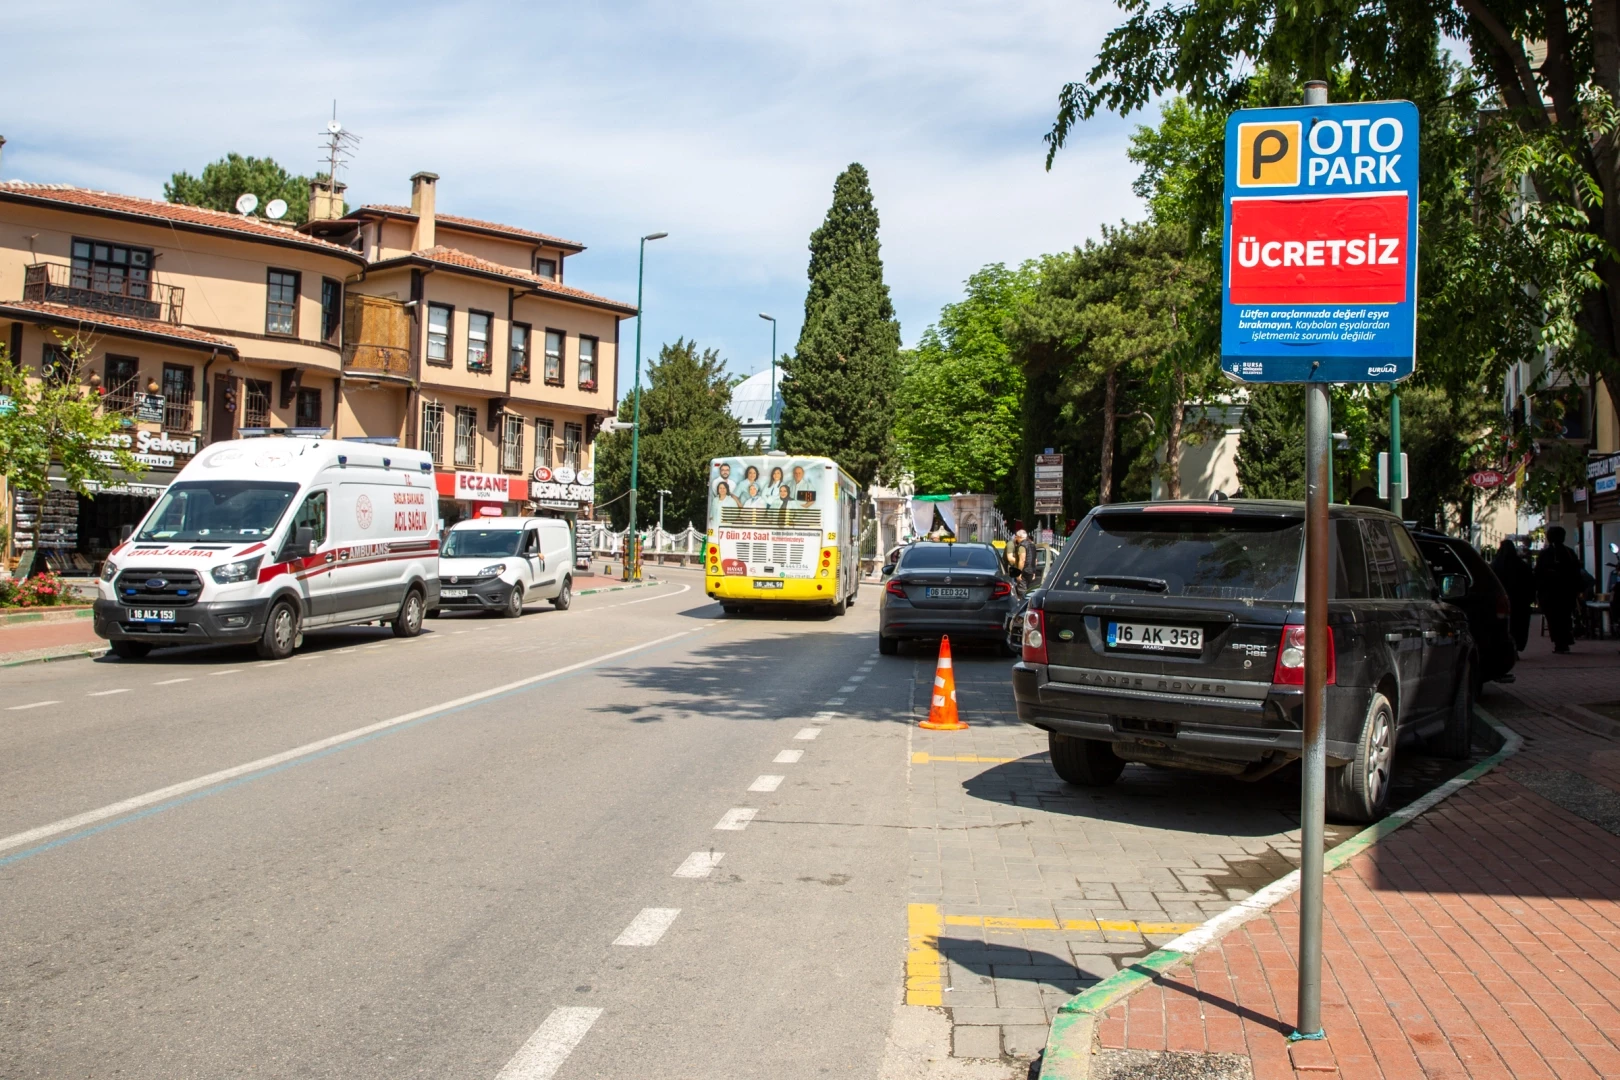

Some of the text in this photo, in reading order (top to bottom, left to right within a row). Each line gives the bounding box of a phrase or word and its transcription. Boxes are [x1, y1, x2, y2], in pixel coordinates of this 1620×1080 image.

[1309, 117, 1404, 155] OTO
[1252, 129, 1289, 180] P
[1308, 154, 1402, 185] PARK
[1237, 233, 1399, 267] ÜCRETSİZ
[1240, 309, 1389, 320] Lütfen araçlarınızda değerli eşya
[1238, 320, 1390, 331] bırakmayın. Kaybolan eşyalardan
[1251, 331, 1376, 342] işletmemiz sorumlu değildir
[136, 430, 197, 454] Şekeri
[460, 475, 508, 492] ECZANE
[394, 511, 407, 531] ACİL
[407, 509, 427, 531] SAĞLIK
[719, 531, 770, 541] 7 Gün 24 Saat
[350, 542, 389, 559] AMBULANS
[930, 588, 939, 596] 06
[954, 588, 968, 596] 324
[133, 609, 173, 619] 16 ALZ 153
[1117, 625, 1200, 646] 16 AK 358
[1231, 643, 1268, 651] SPORT
[1157, 680, 1227, 694] ROVER
